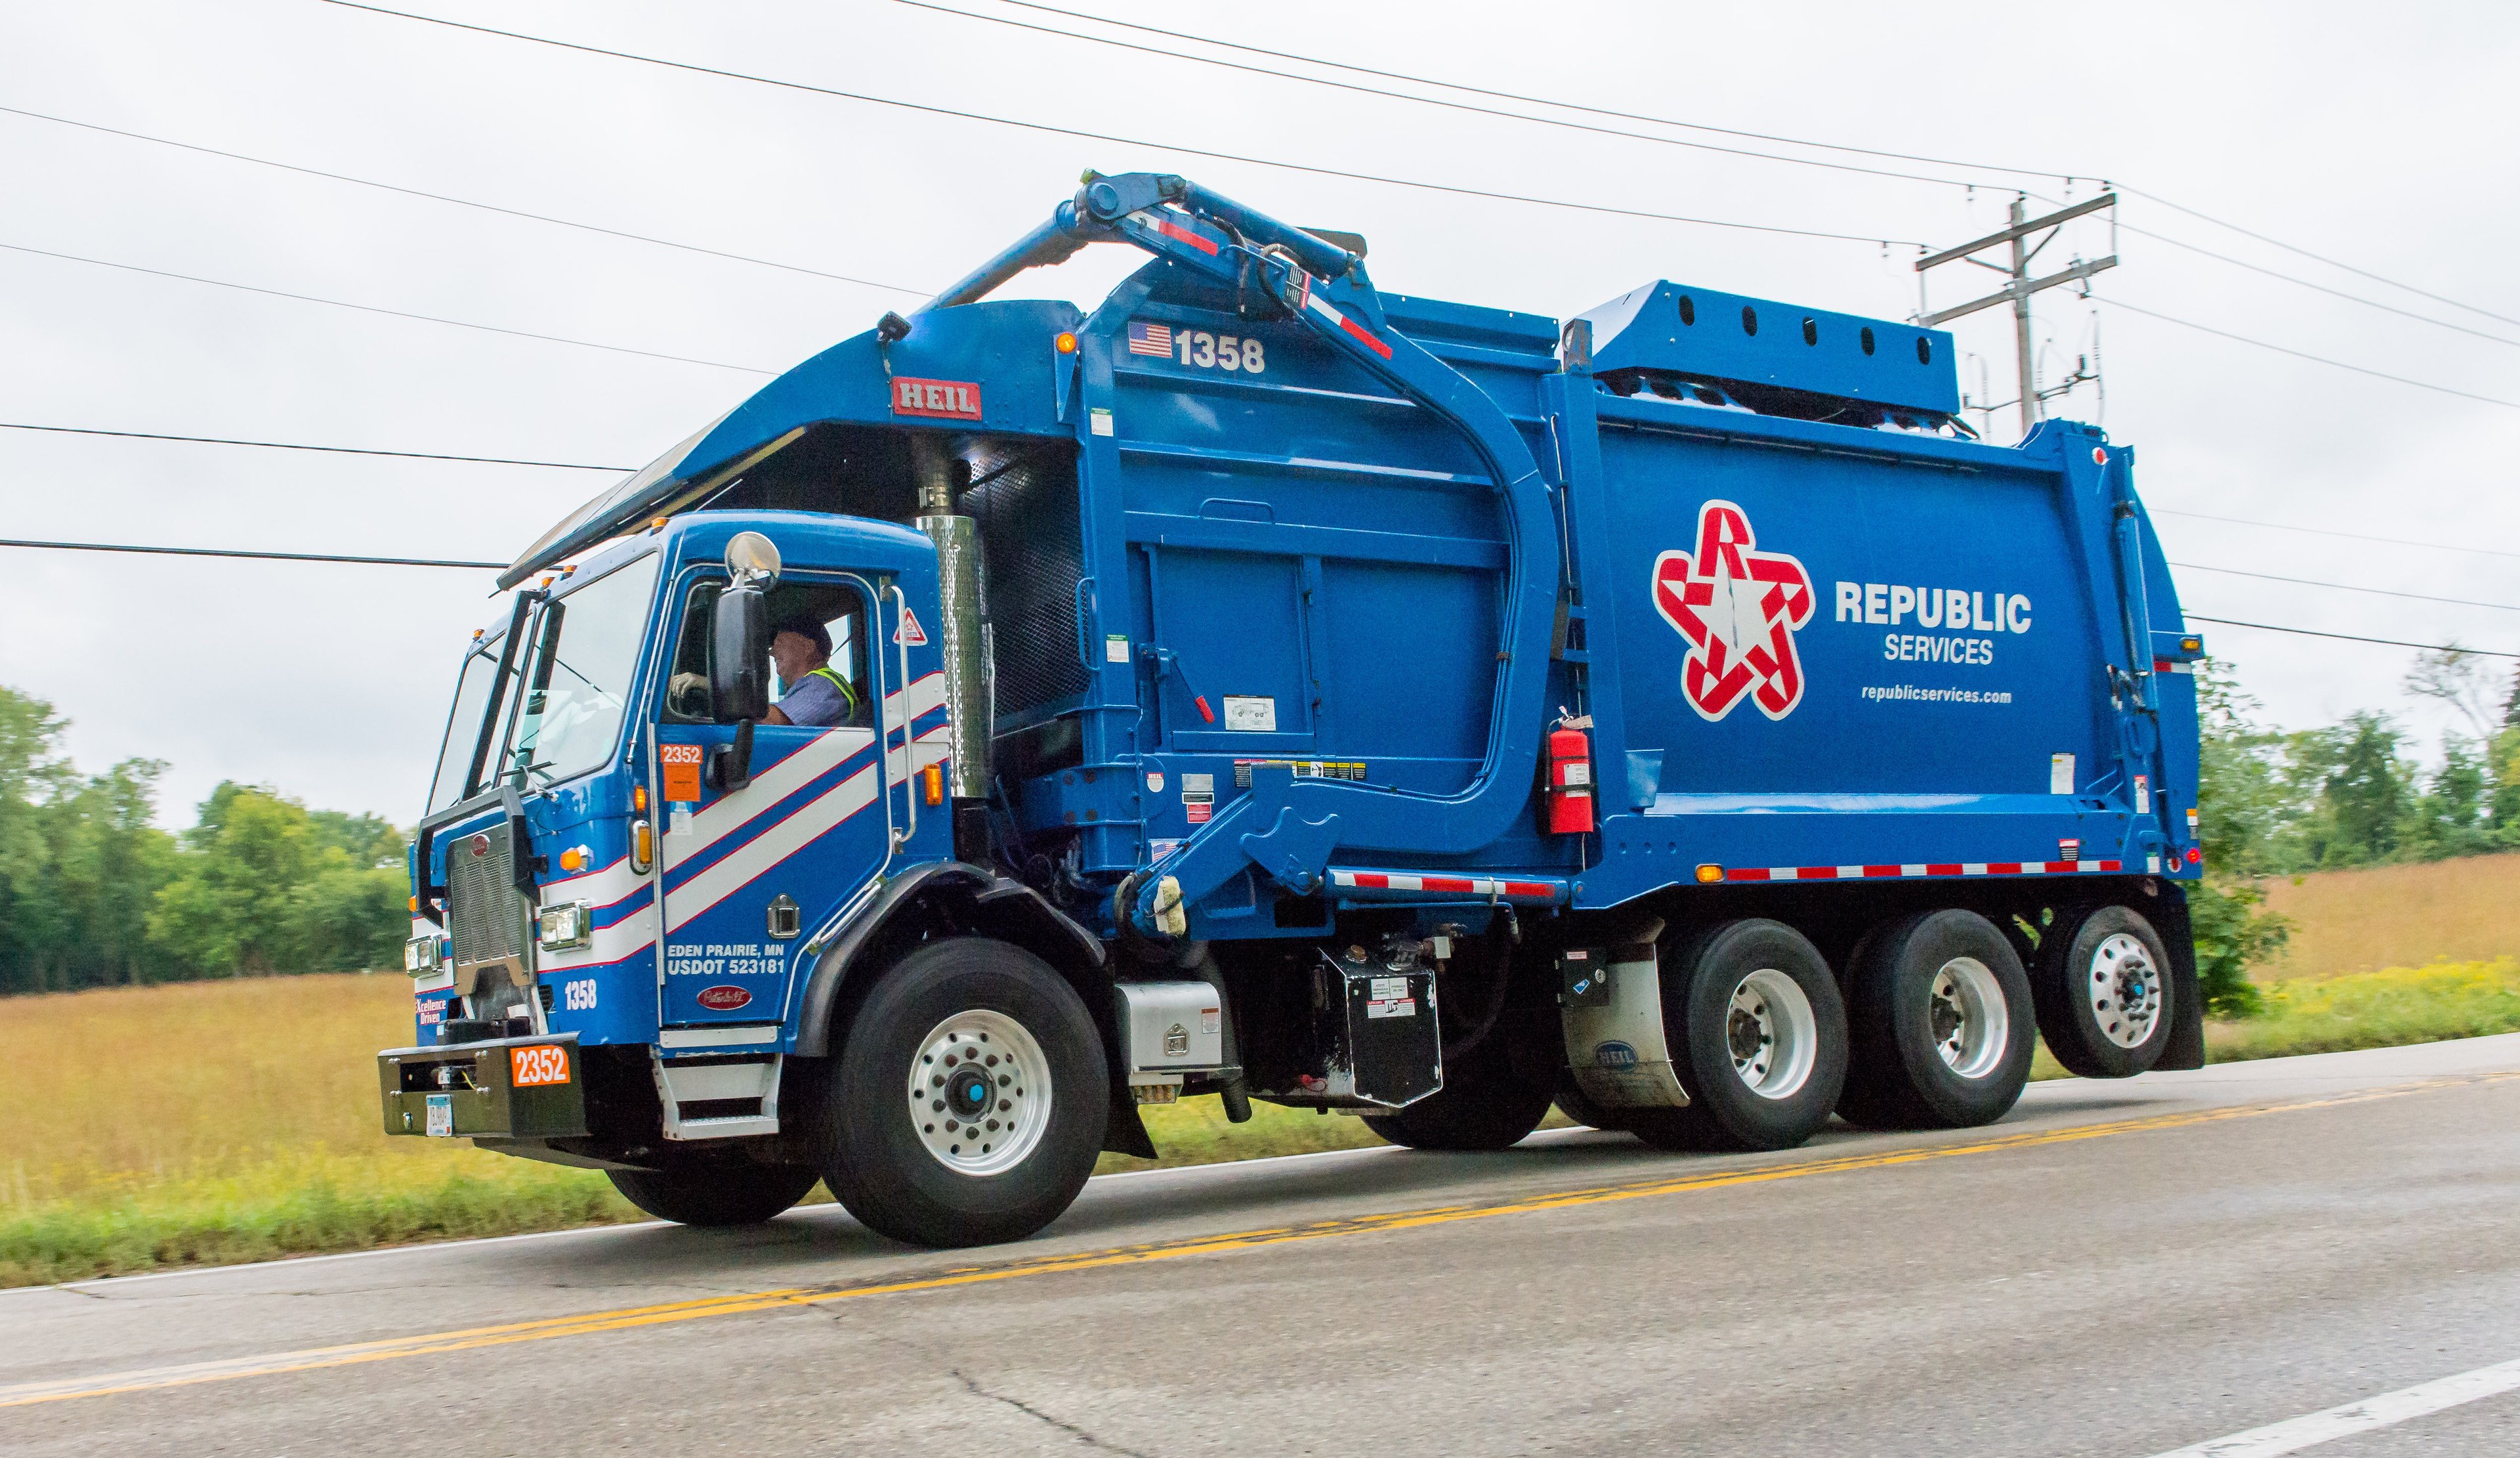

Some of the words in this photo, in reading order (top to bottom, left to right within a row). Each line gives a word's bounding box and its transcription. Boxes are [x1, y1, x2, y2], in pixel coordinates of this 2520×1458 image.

[1175, 330, 1265, 374] 1358
[900, 383, 976, 413] HEIL
[1836, 581, 2032, 633] REPUBLIC
[1884, 633, 1994, 665] SERVICES
[1862, 684, 2012, 704] republicservices.com
[663, 746, 700, 763] 2352
[667, 945, 702, 957] EDEN
[705, 944, 761, 958] PRAIRIE,
[764, 944, 784, 956] MN
[667, 959, 725, 975] USDOT
[728, 958, 785, 974] 523181
[565, 979, 597, 1010] 1358
[421, 1011, 440, 1025] Driven
[516, 1048, 566, 1083] 2352
